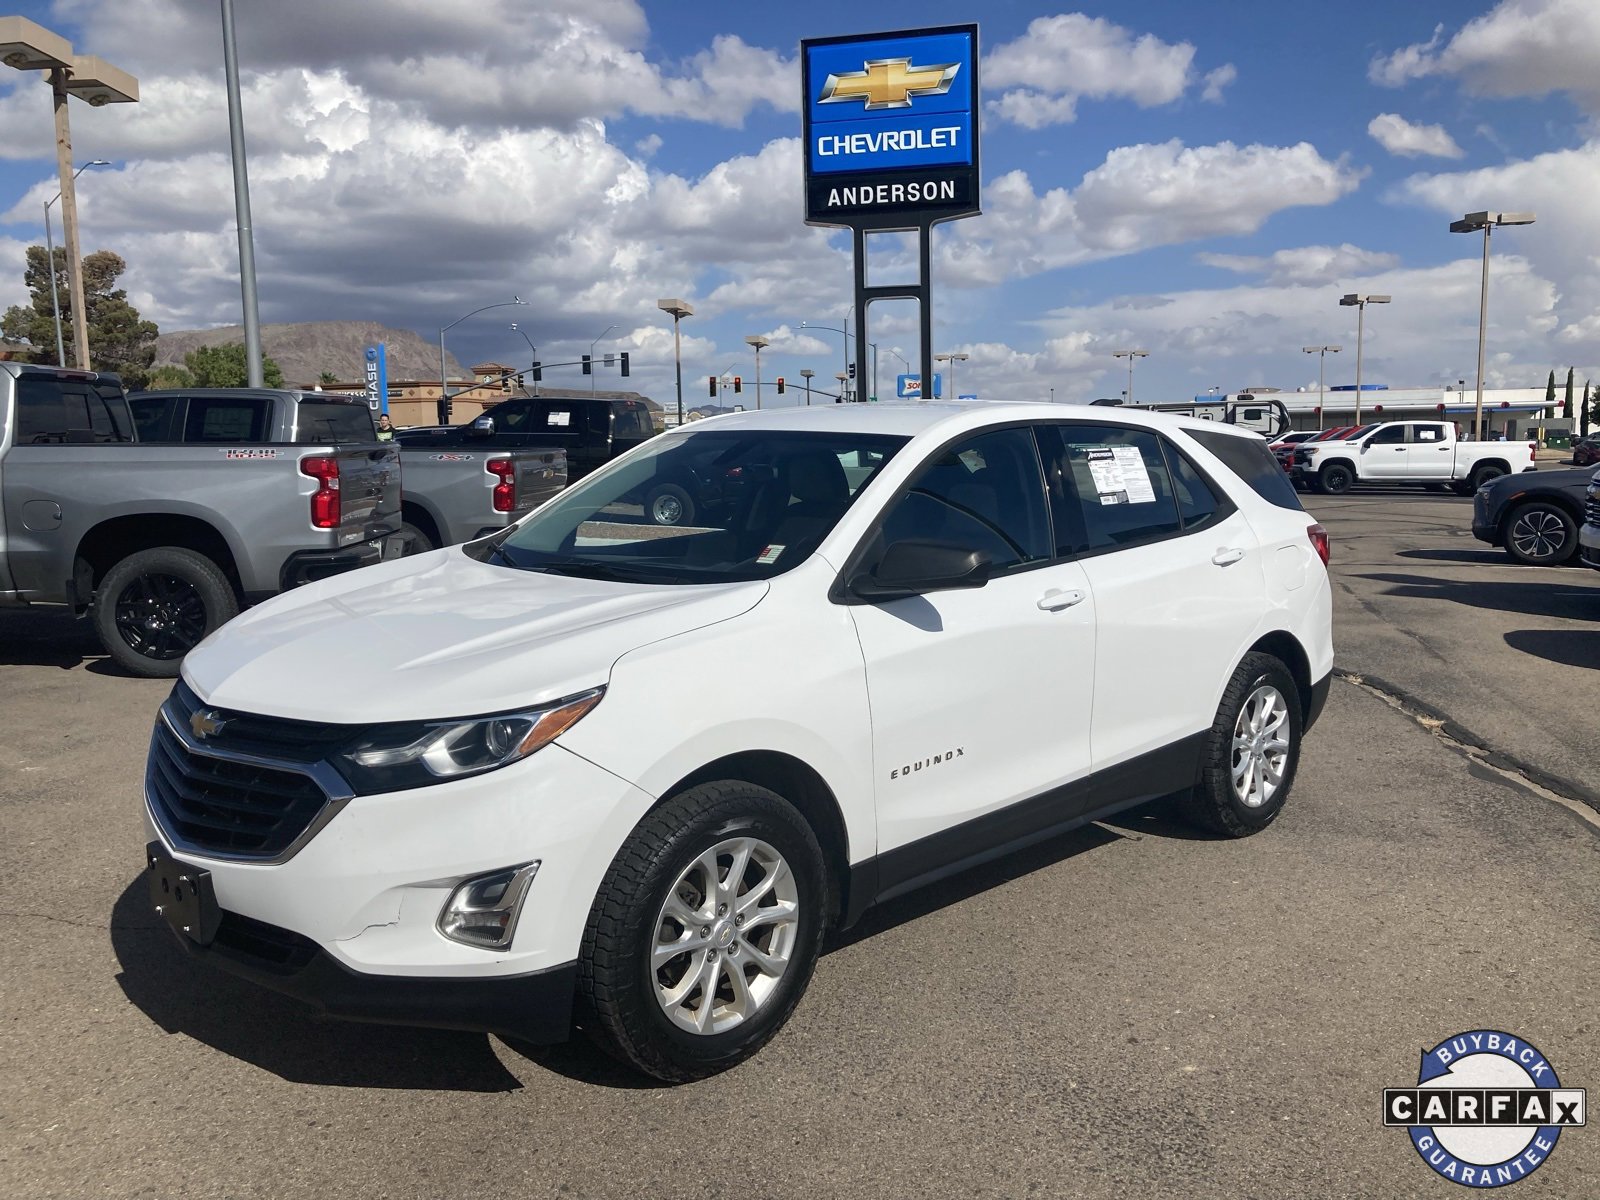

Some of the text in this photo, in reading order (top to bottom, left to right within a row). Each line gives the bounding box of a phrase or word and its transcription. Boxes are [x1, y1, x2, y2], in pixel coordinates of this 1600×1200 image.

[818, 126, 961, 157] CHEVROLET
[828, 180, 956, 207] ANDERSON
[367, 362, 379, 410] CHASE
[890, 747, 965, 780] EQUINOX
